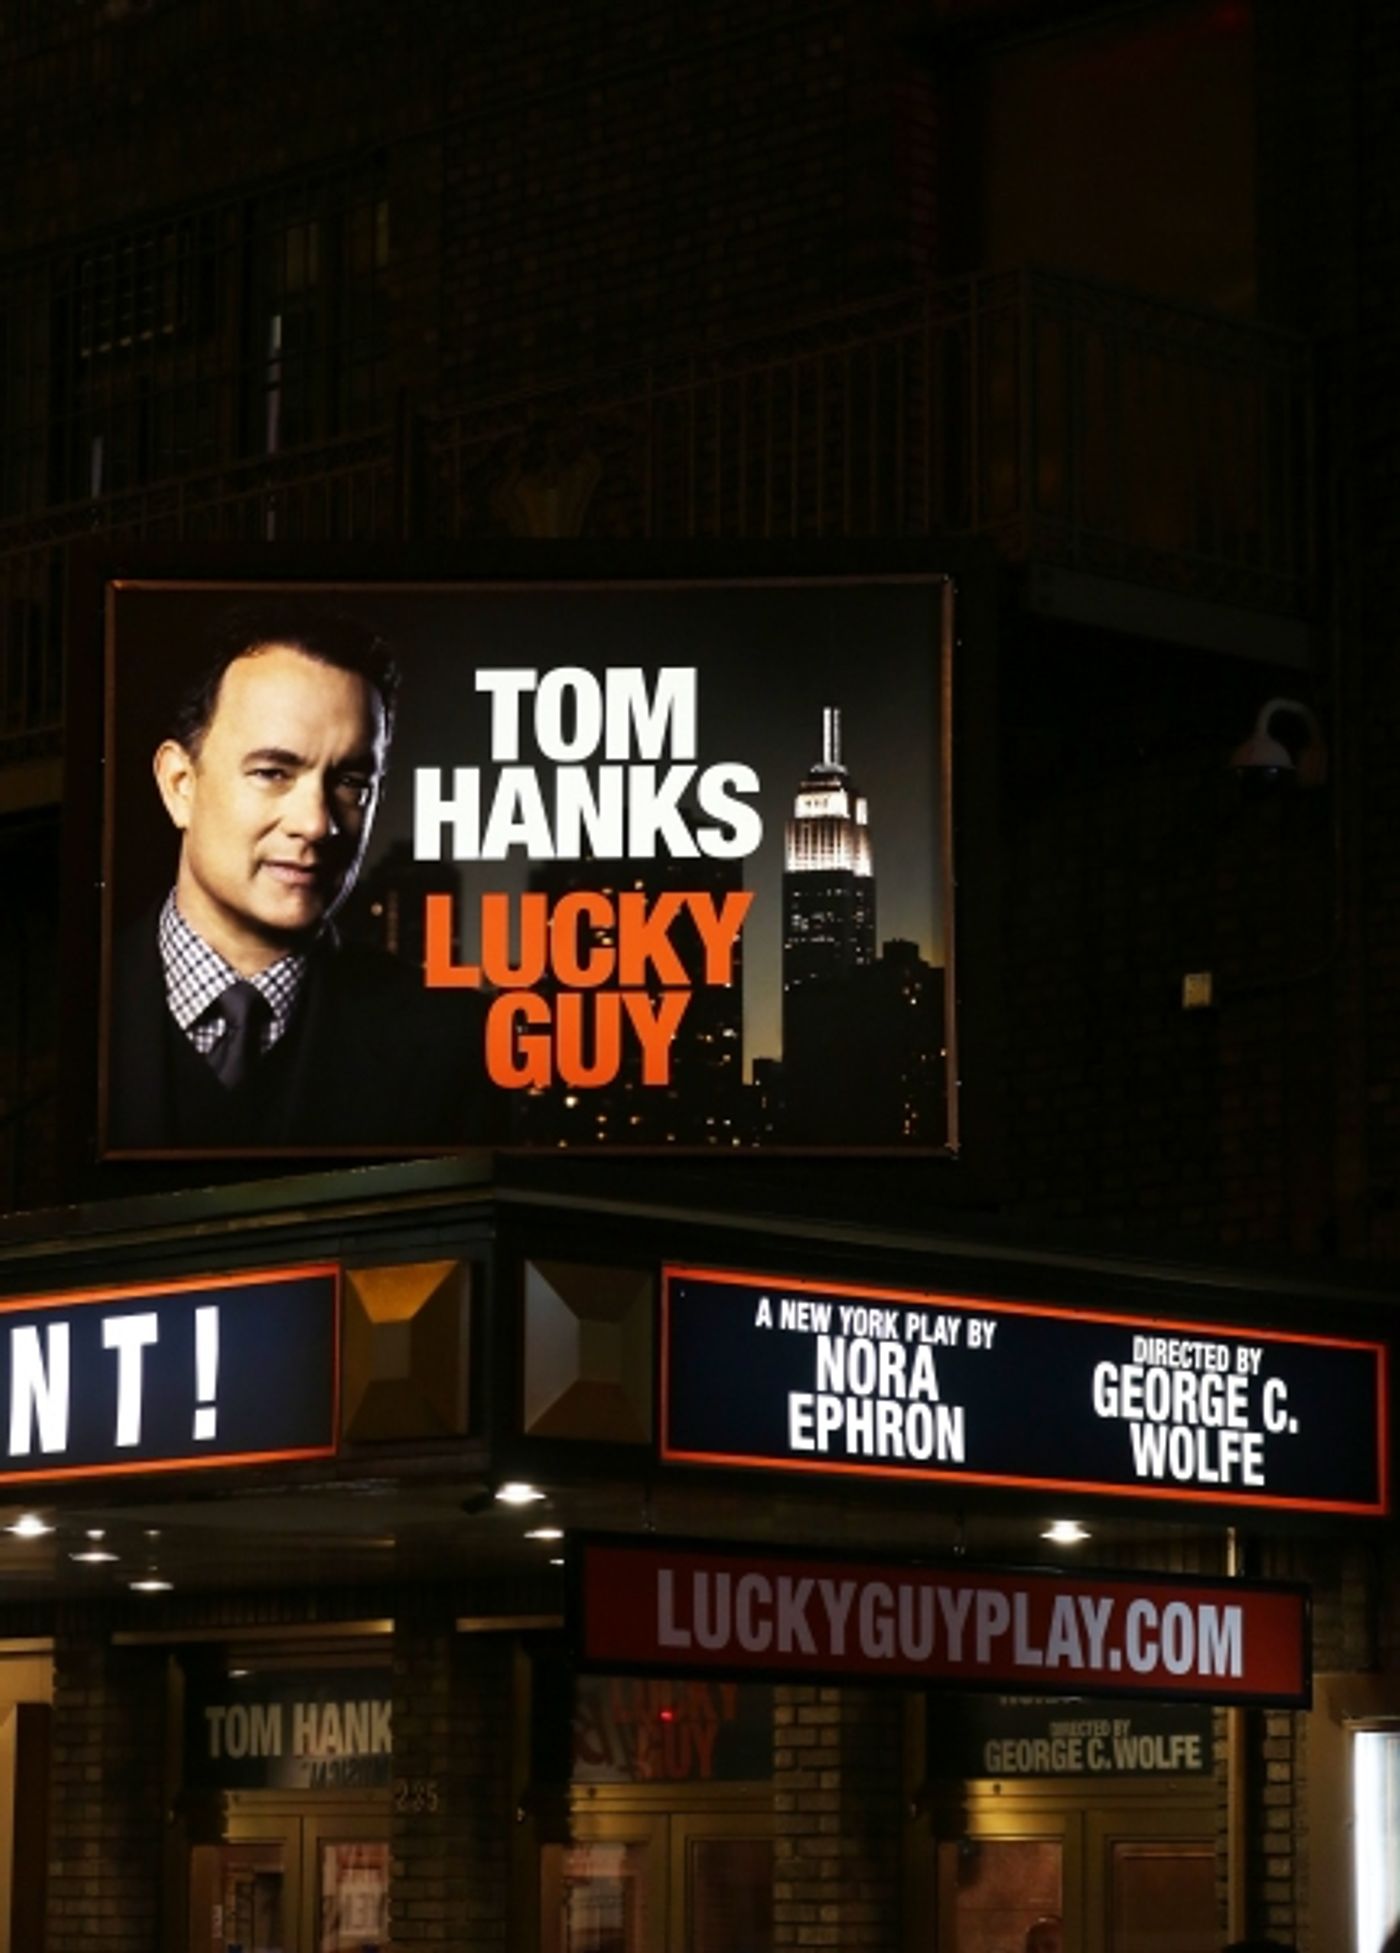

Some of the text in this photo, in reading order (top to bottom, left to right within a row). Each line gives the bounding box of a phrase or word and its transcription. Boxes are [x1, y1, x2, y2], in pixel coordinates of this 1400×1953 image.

[474, 666, 698, 763] TOM
[413, 761, 764, 861] HANKS
[424, 891, 756, 989] LUCKY
[484, 991, 693, 1088] GUY
[755, 1297, 997, 1350] A NEW YORK PLAY BY
[1132, 1335, 1263, 1376] DIRECTED BY
[816, 1334, 940, 1402] NORA
[1093, 1360, 1298, 1434] GEORGE C.
[788, 1392, 966, 1463] EPHRON
[1129, 1422, 1265, 1487] WOLFE
[657, 1568, 1243, 1678] LUCKYGUYPLAY.COM
[205, 1703, 282, 1759] TOM
[984, 1733, 1202, 1774] GEORGE C. WOLFE
[1112, 1718, 1132, 1737] BY
